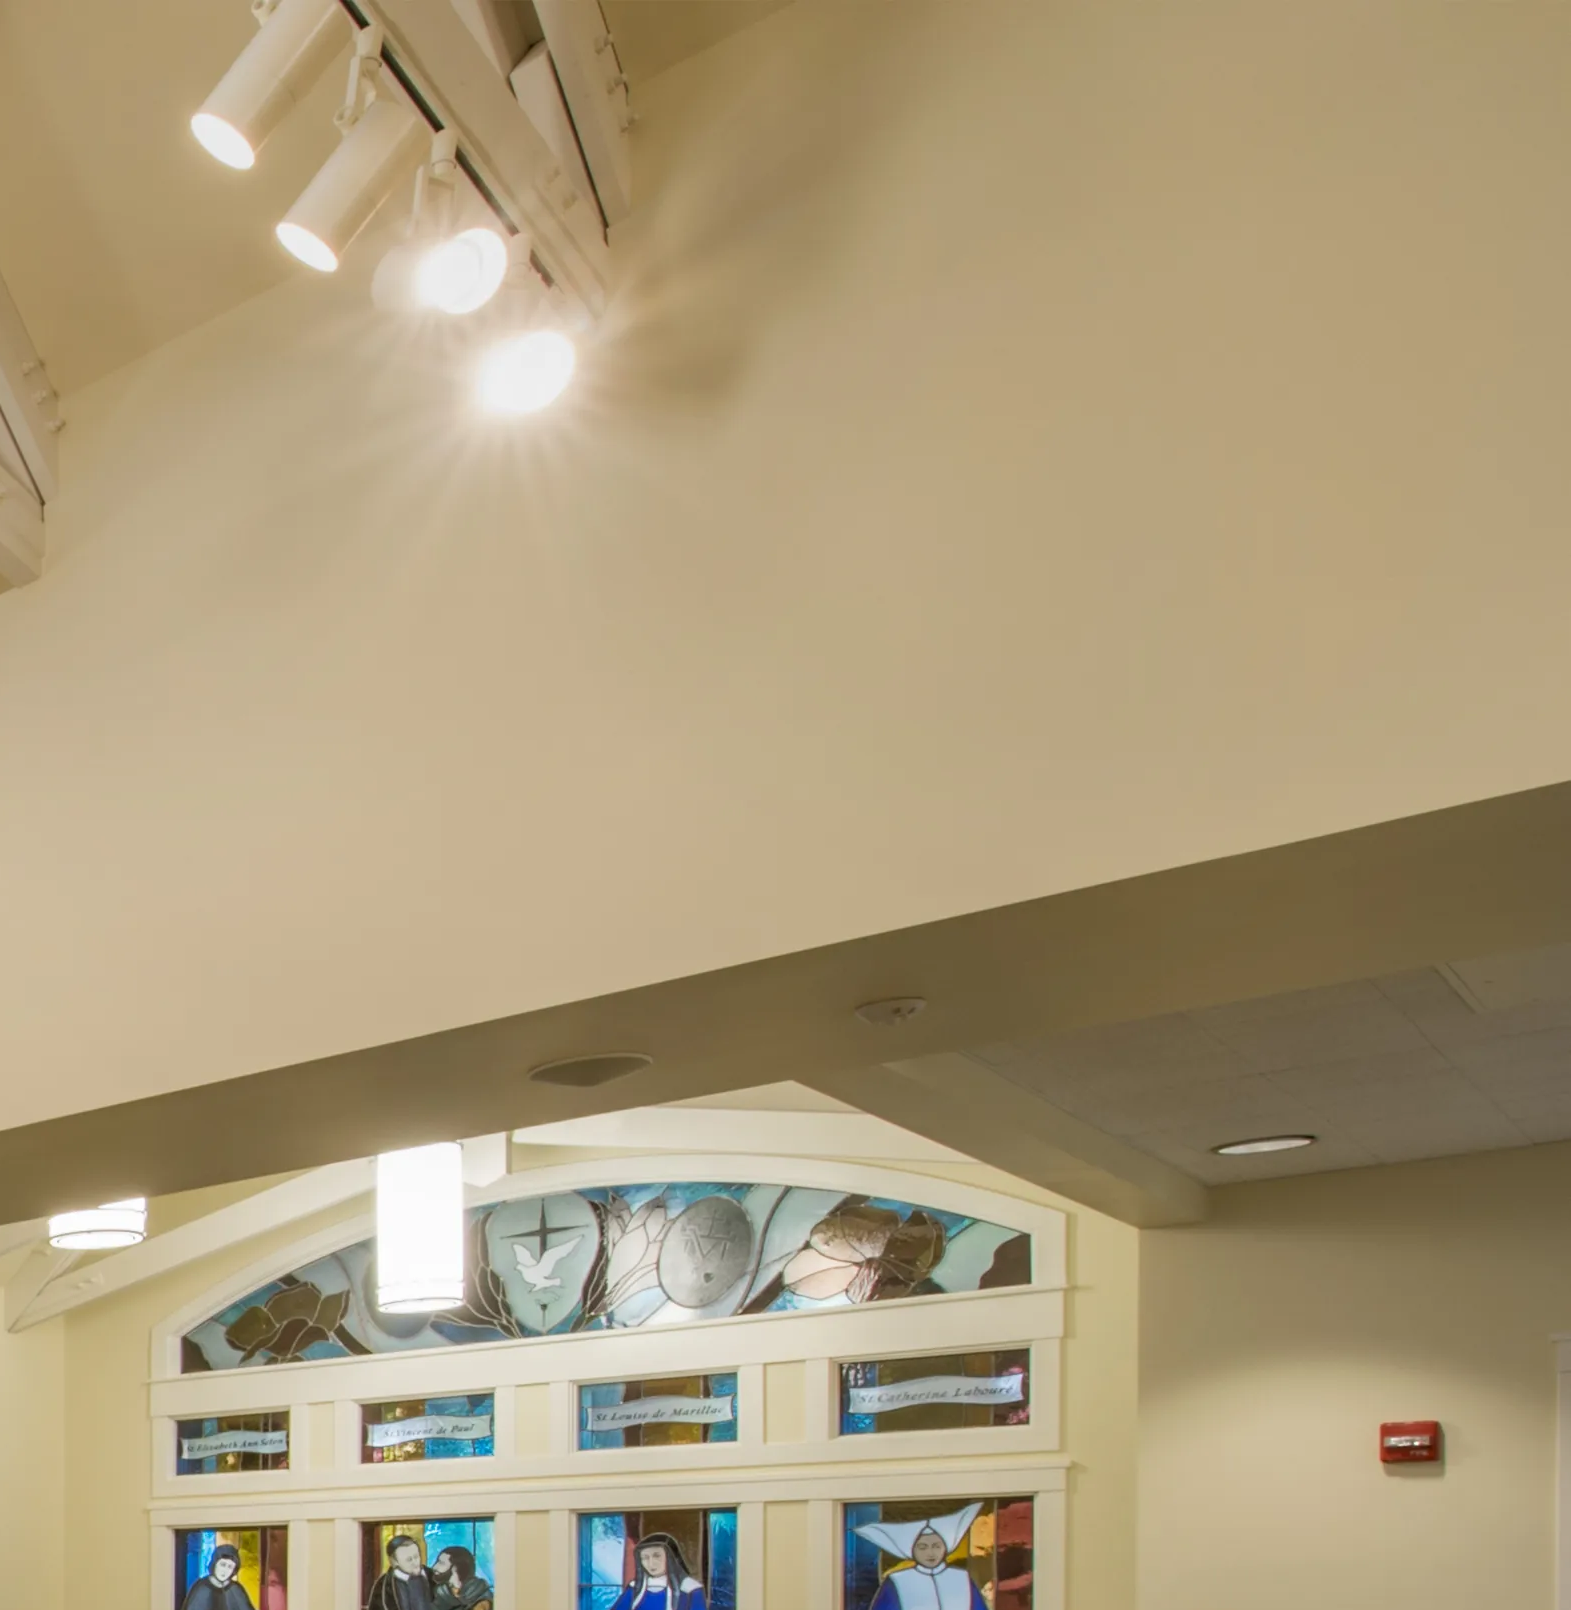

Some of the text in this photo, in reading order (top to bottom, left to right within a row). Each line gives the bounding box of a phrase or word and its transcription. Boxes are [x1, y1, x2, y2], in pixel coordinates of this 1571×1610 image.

[877, 1390, 947, 1403] Catherine
[611, 1410, 649, 1421] Louise
[651, 1409, 666, 1418] de
[669, 1404, 723, 1417] Marillac
[396, 1427, 433, 1436] Vincent
[436, 1426, 447, 1435] de
[450, 1423, 475, 1433] Paul
[196, 1441, 237, 1453] Elizabeth
[240, 1439, 258, 1449] Ann
[259, 1437, 284, 1446] Seton
